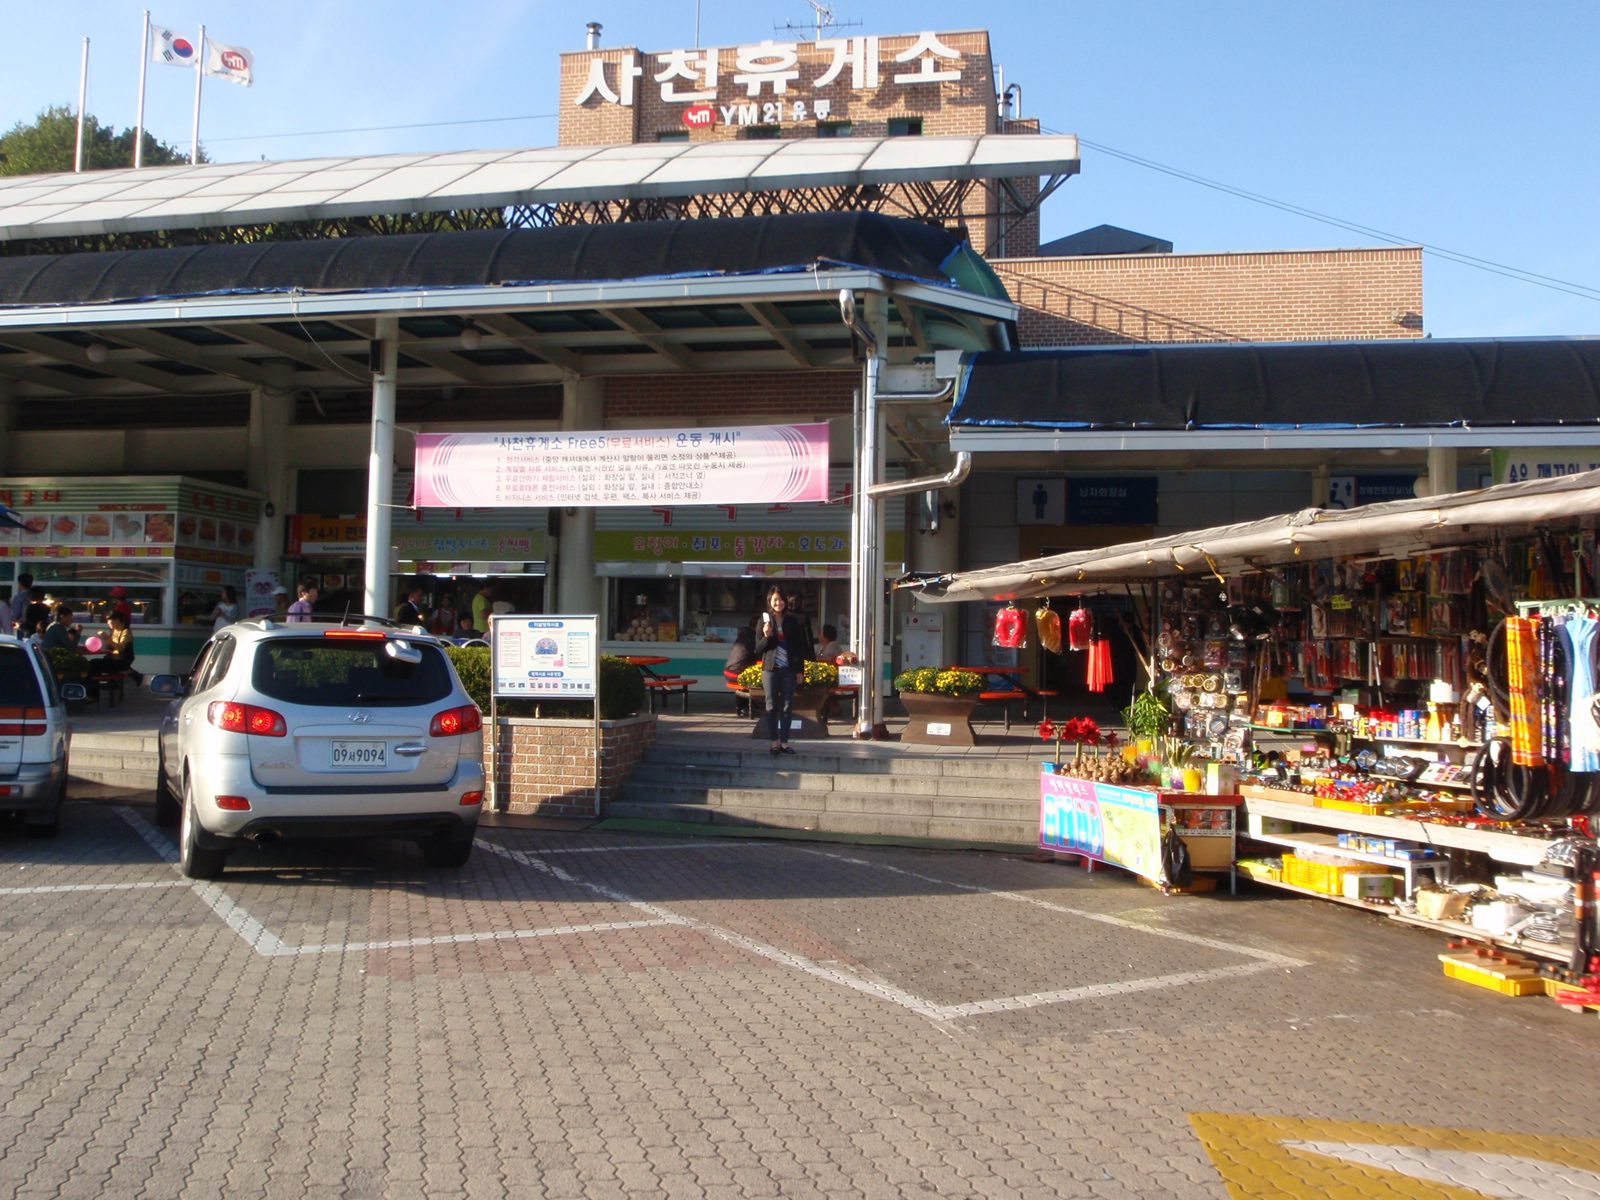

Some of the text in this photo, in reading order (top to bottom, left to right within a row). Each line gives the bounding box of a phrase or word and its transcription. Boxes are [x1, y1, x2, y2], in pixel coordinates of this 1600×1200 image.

[576, 31, 963, 107] 사천휴게소
[676, 432, 702, 448] 운동
[660, 491, 680, 499] 서비스
[1080, 487, 1127, 497] 남자화장실
[308, 526, 339, 541] 24시
[633, 536, 679, 555] 오징어
[734, 535, 784, 558] 통감자
[800, 536, 852, 551] 호도과
